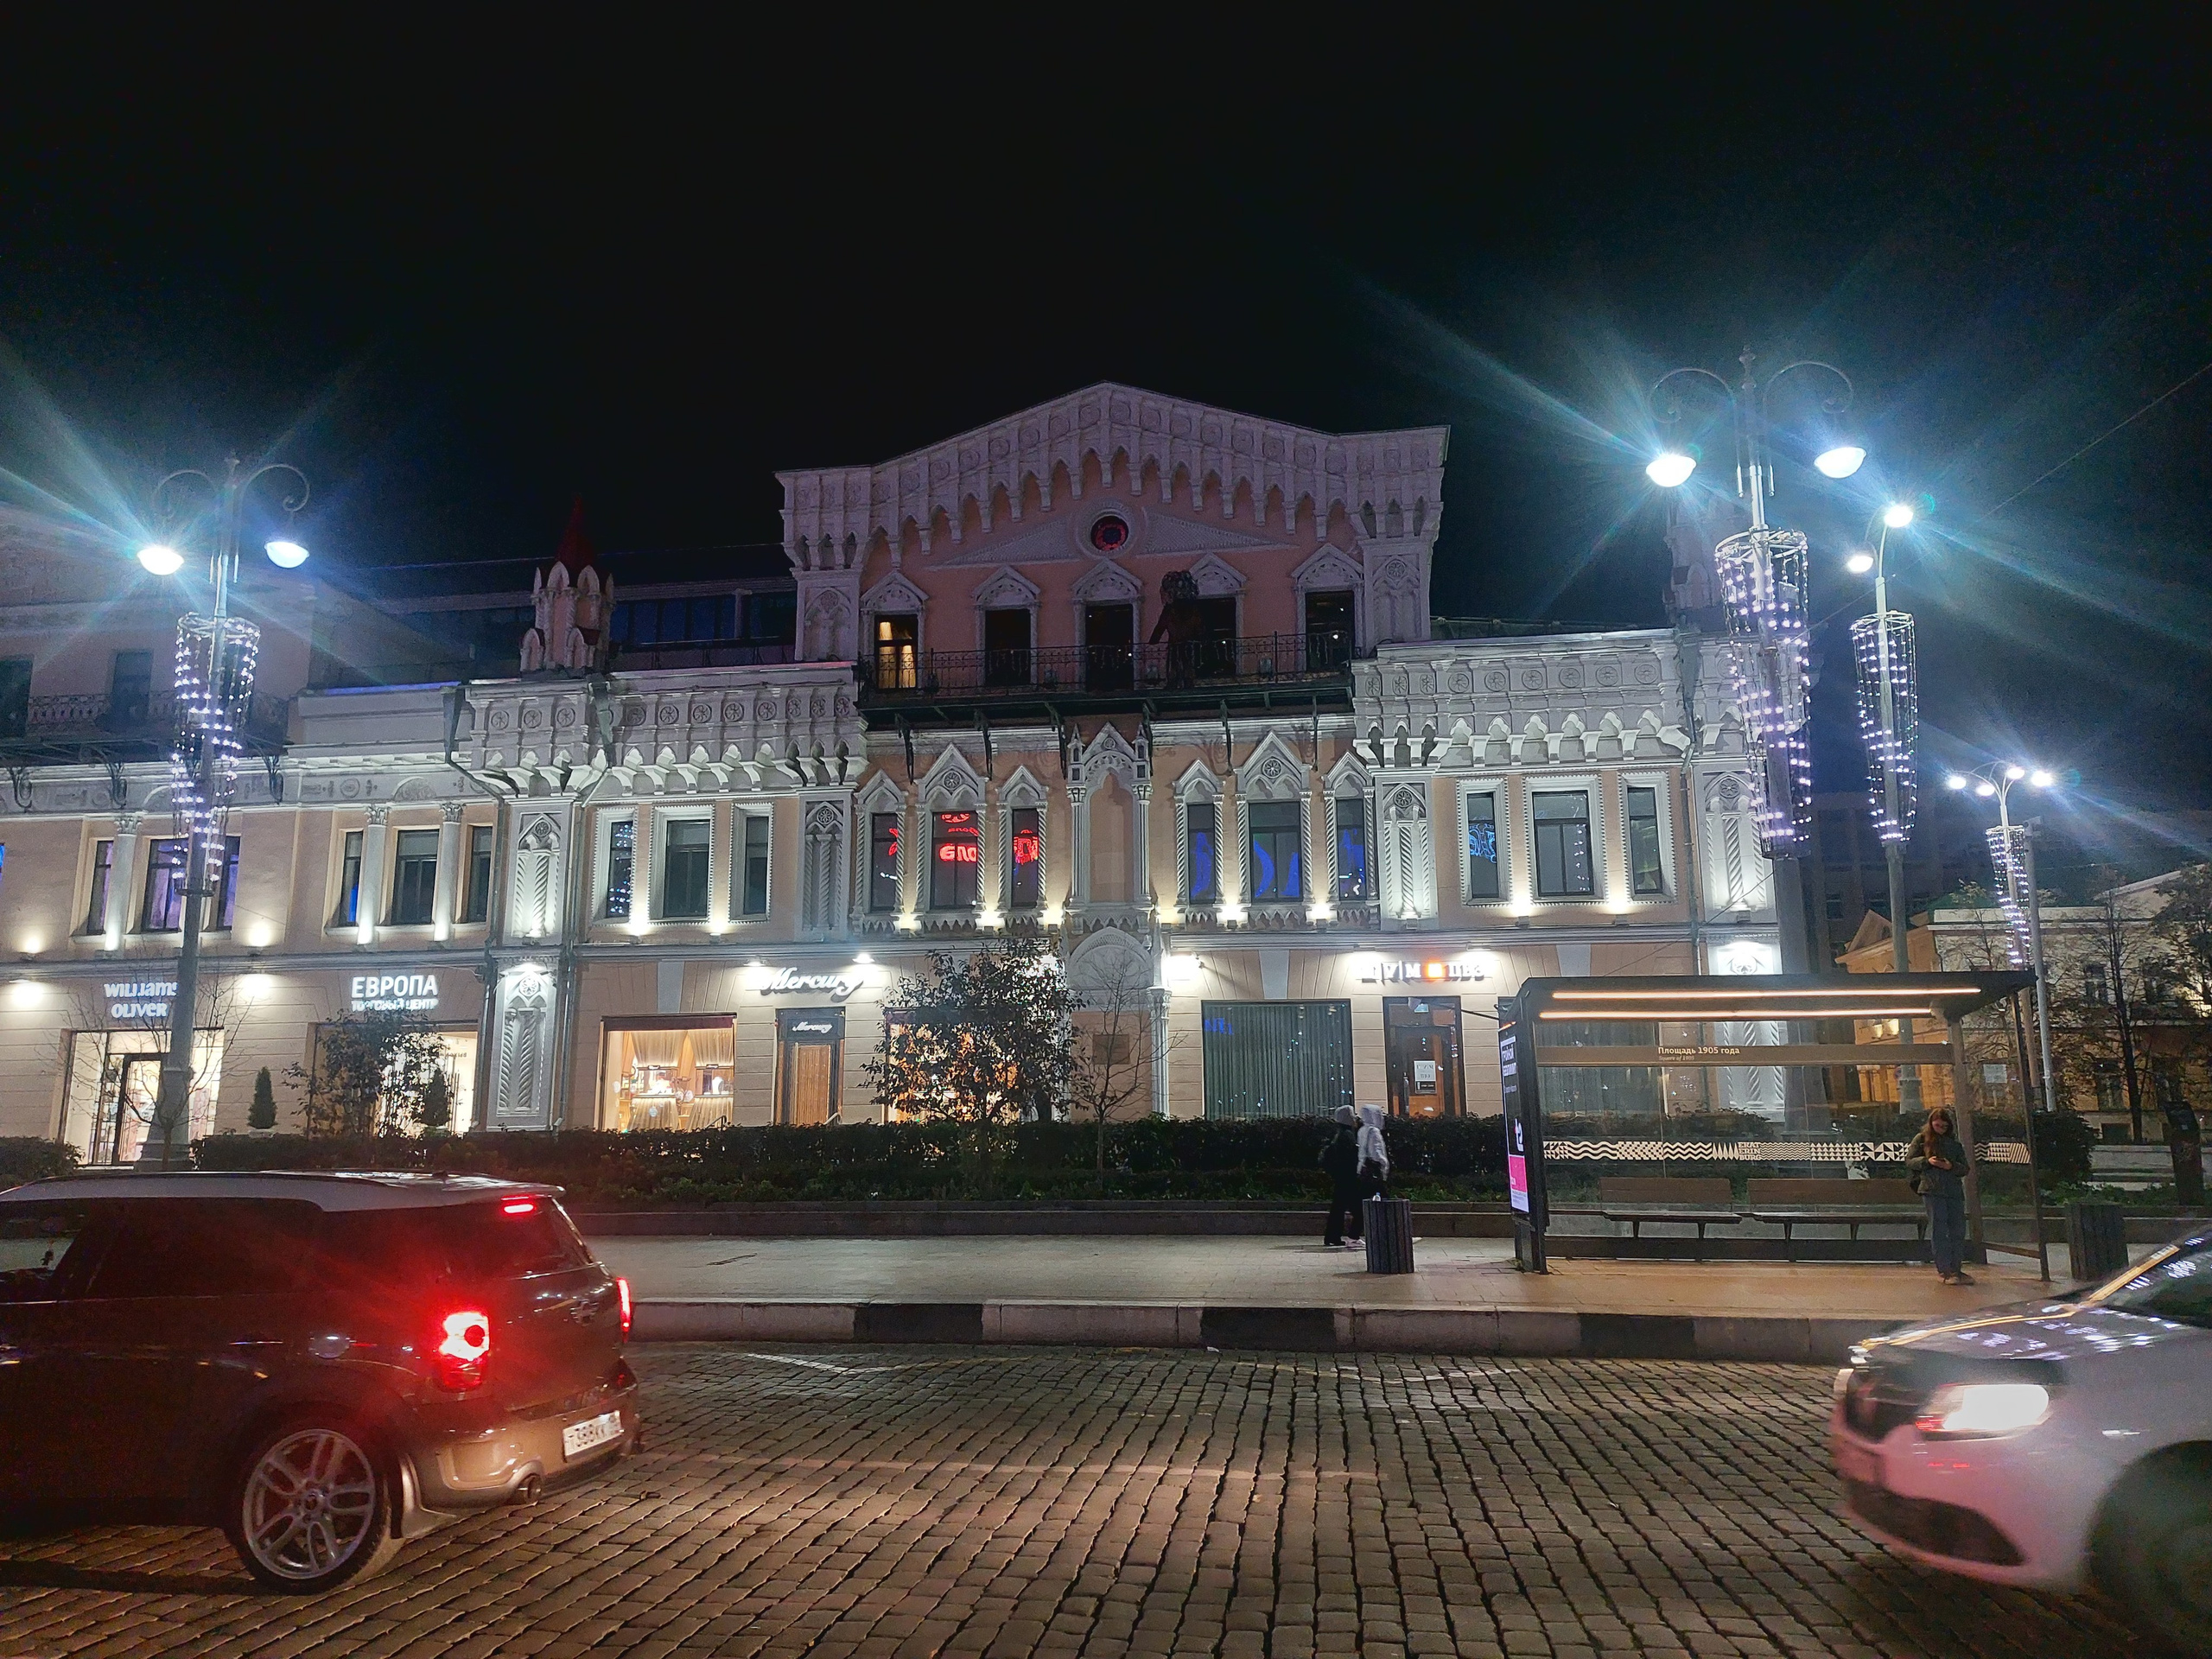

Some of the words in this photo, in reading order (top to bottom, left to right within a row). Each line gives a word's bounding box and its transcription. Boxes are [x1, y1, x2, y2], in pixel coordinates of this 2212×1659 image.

[351, 975, 439, 998] ЕВРОПА
[760, 967, 864, 996] Mercury
[405, 998, 439, 1011] ЦЕНТР
[791, 1021, 833, 1034] Mercury
[1658, 1046, 1696, 1055] Площадь
